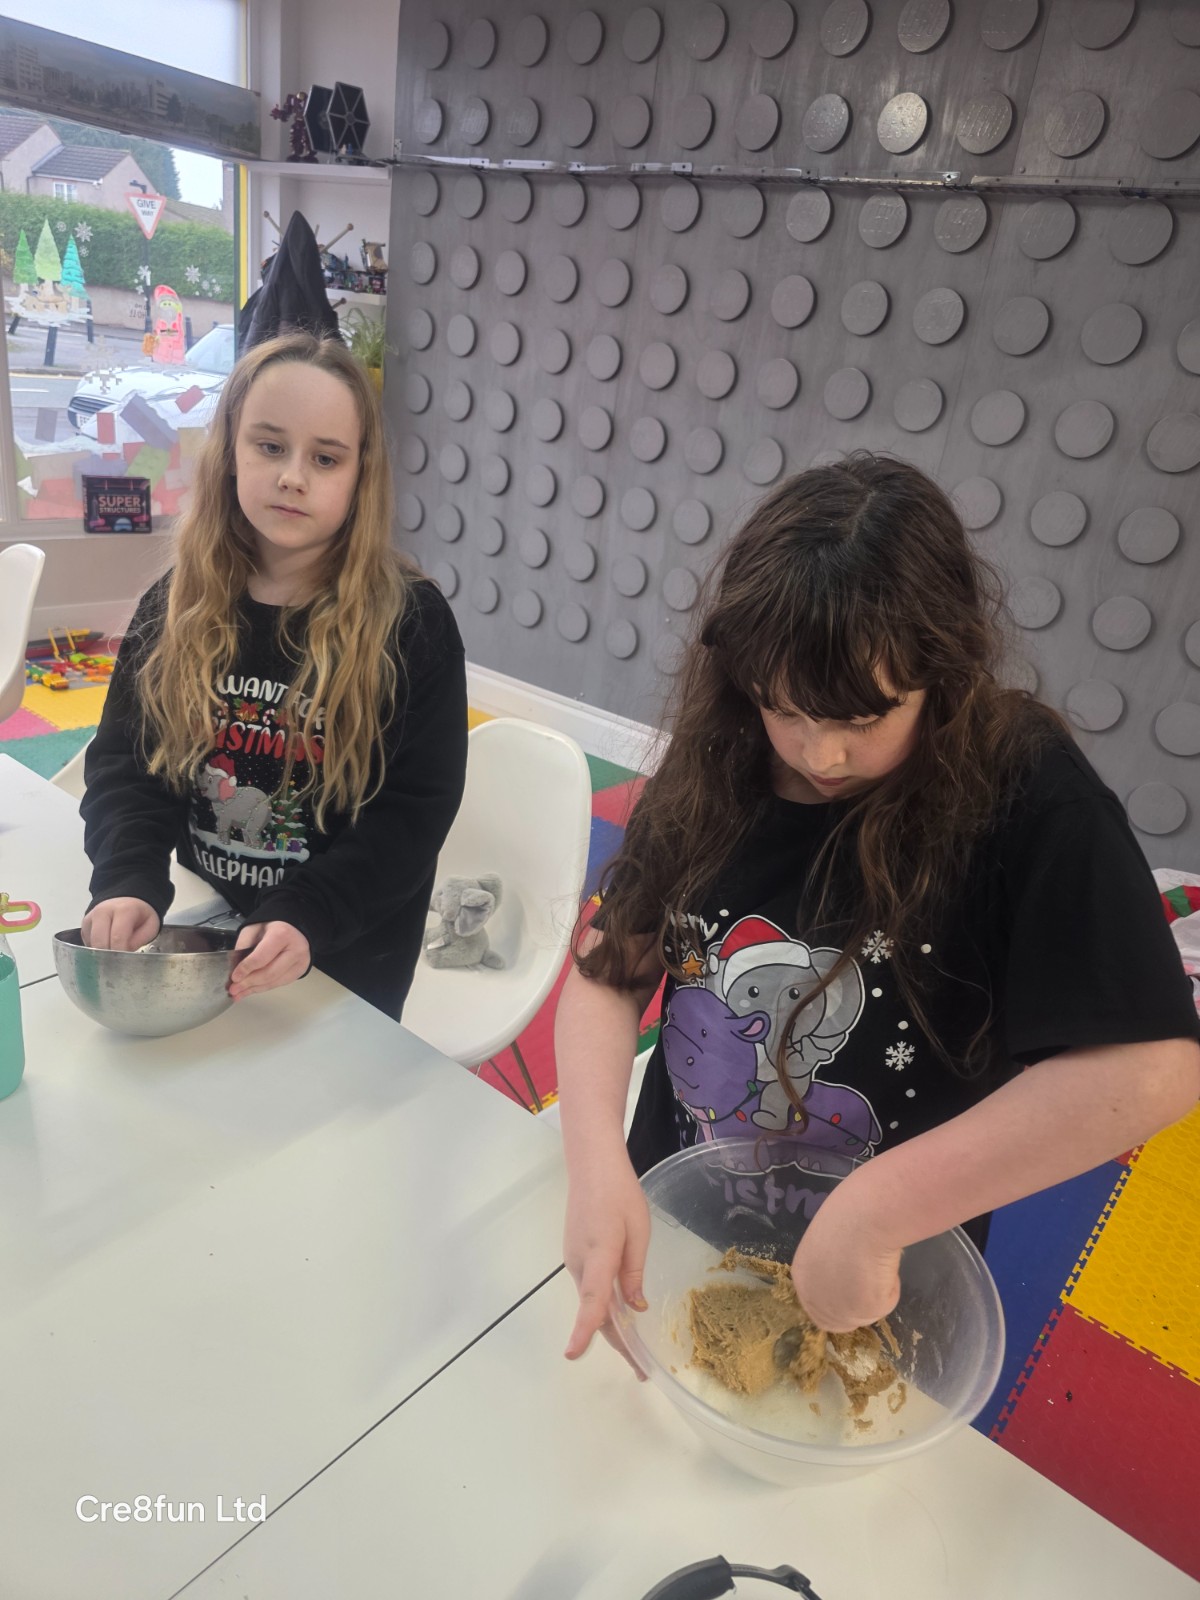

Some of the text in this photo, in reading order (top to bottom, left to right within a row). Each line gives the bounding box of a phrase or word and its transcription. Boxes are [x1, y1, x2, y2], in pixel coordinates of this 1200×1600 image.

[136, 199, 156, 209] GIVE
[98, 496, 141, 507] SUPER
[217, 674, 289, 704] WANT
[212, 716, 326, 765] ISTMAS
[201, 850, 285, 889] ELEPHAN
